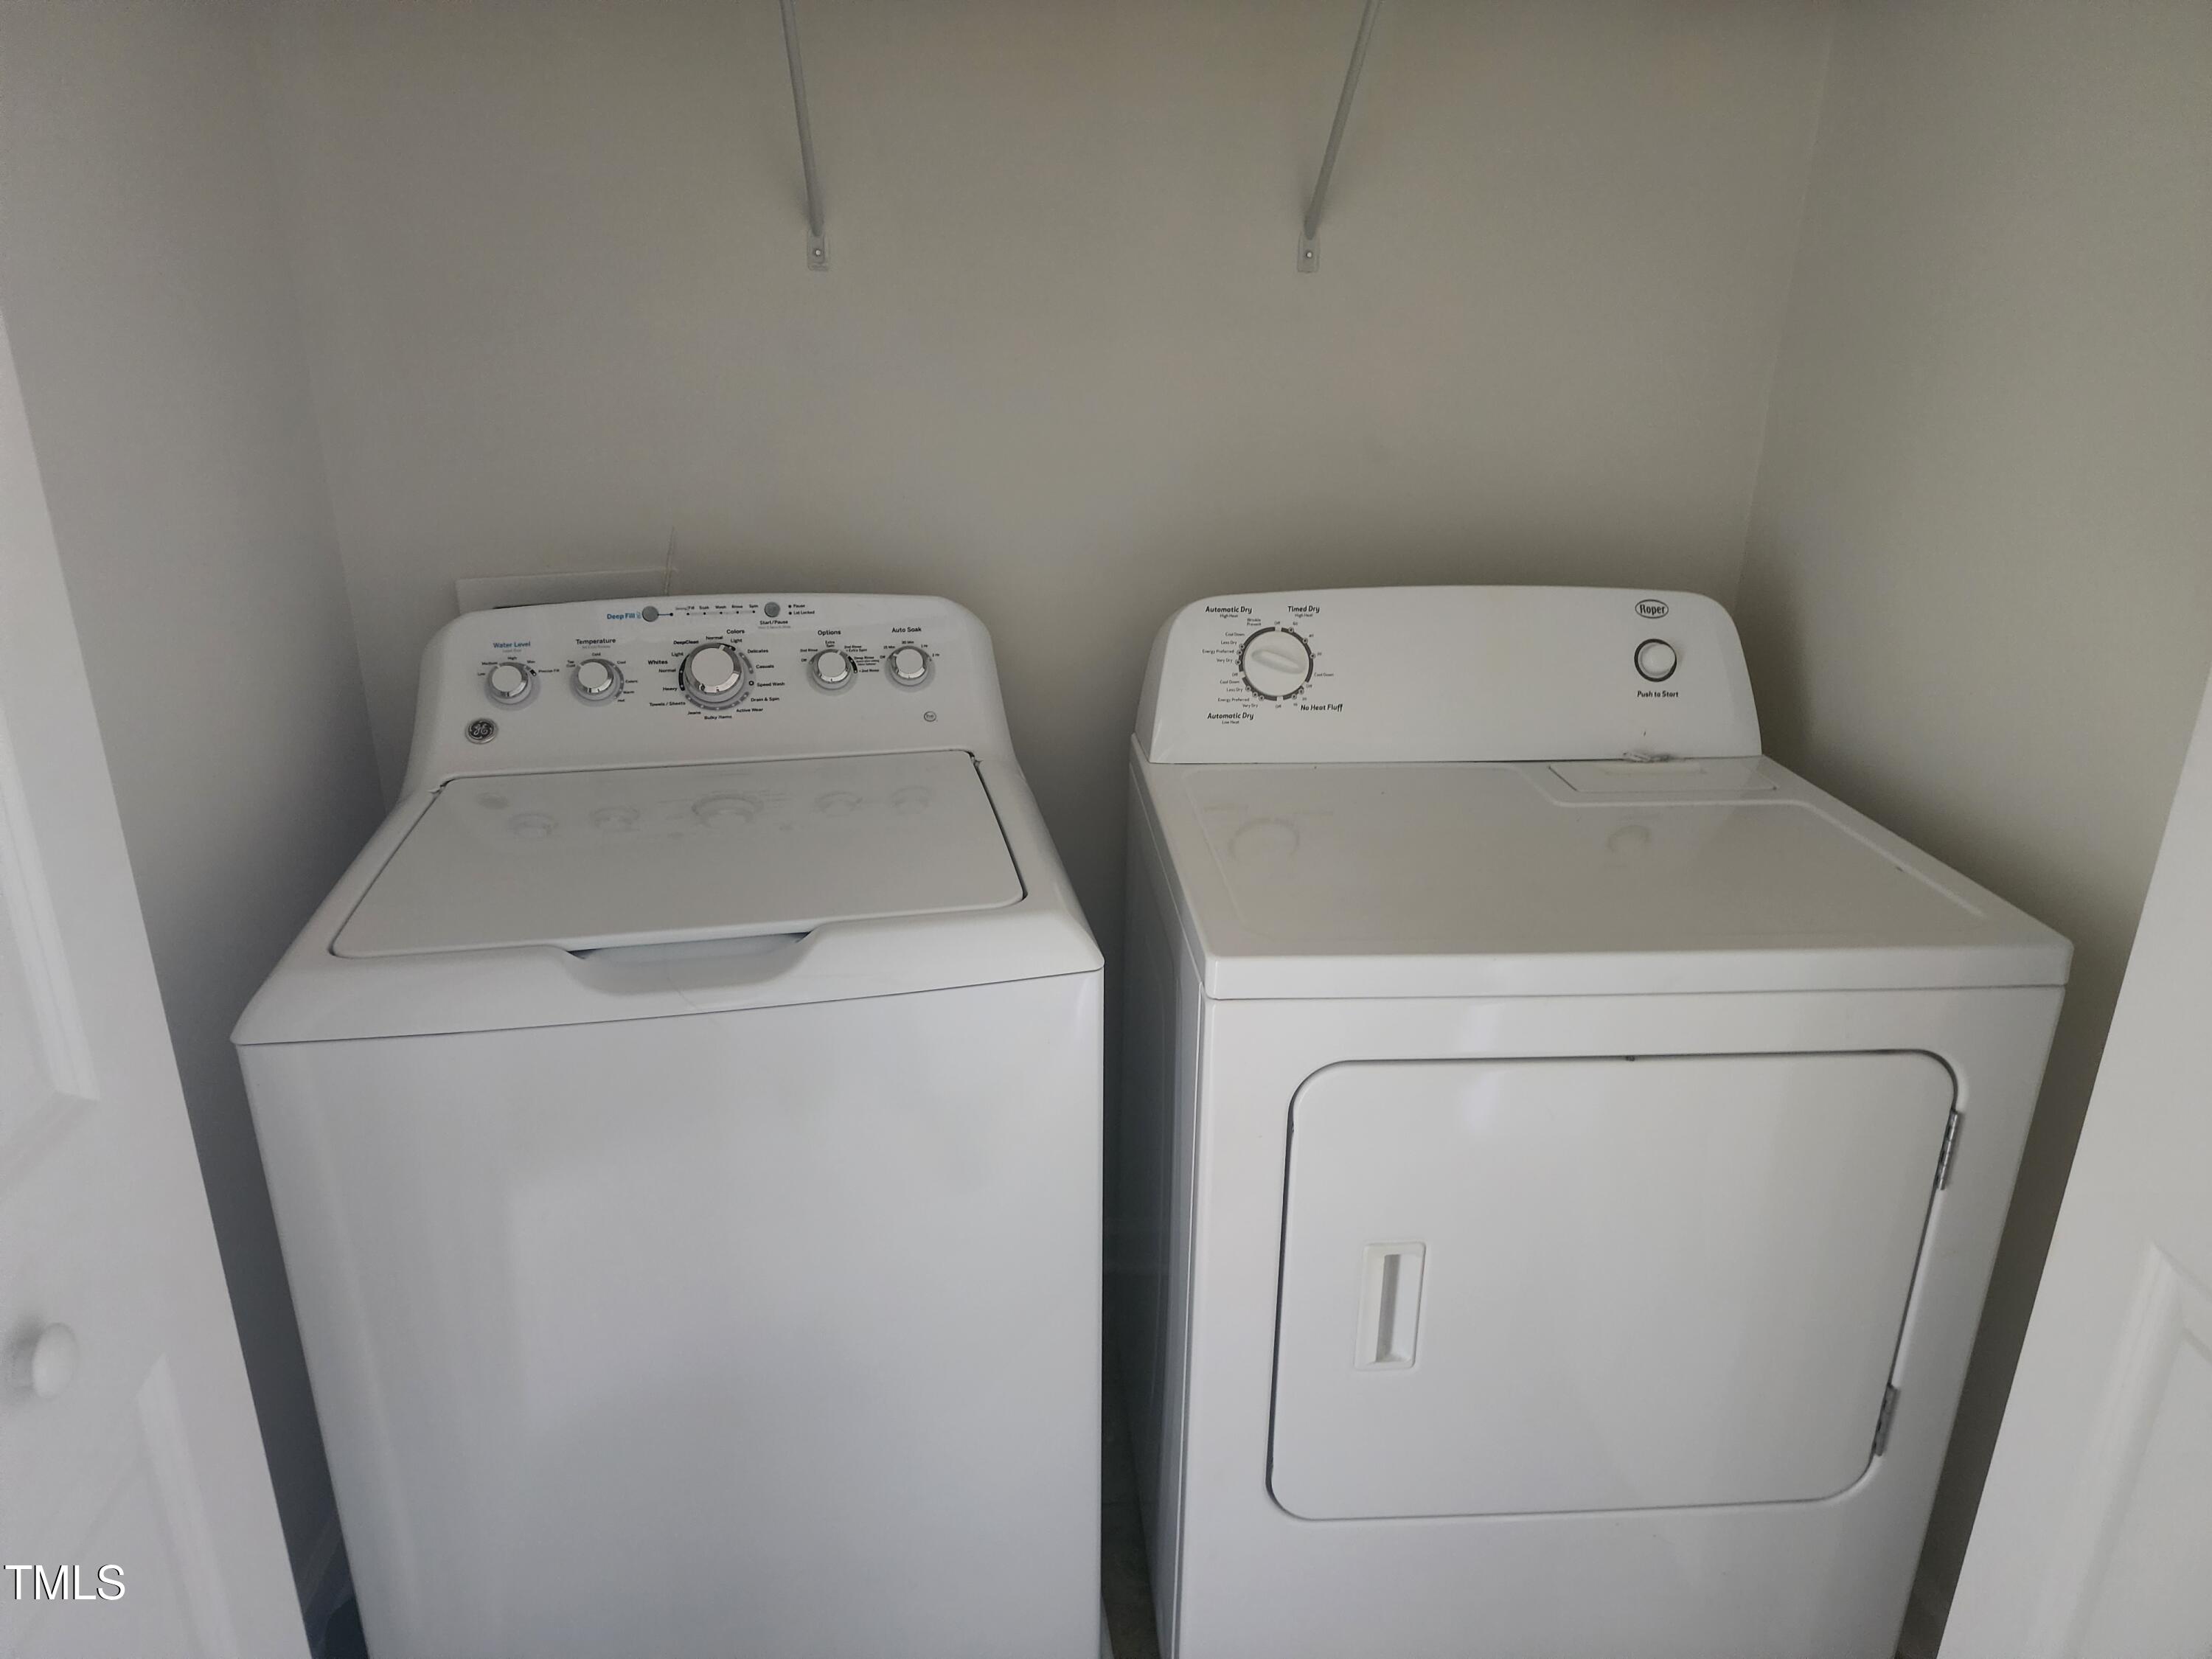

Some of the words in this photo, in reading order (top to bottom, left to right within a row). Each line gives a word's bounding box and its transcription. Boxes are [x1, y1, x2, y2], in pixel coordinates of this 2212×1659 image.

[1240, 606, 1252, 614] Dry
[1640, 604, 1666, 614] Roper
[1242, 712, 1253, 720] Dry
